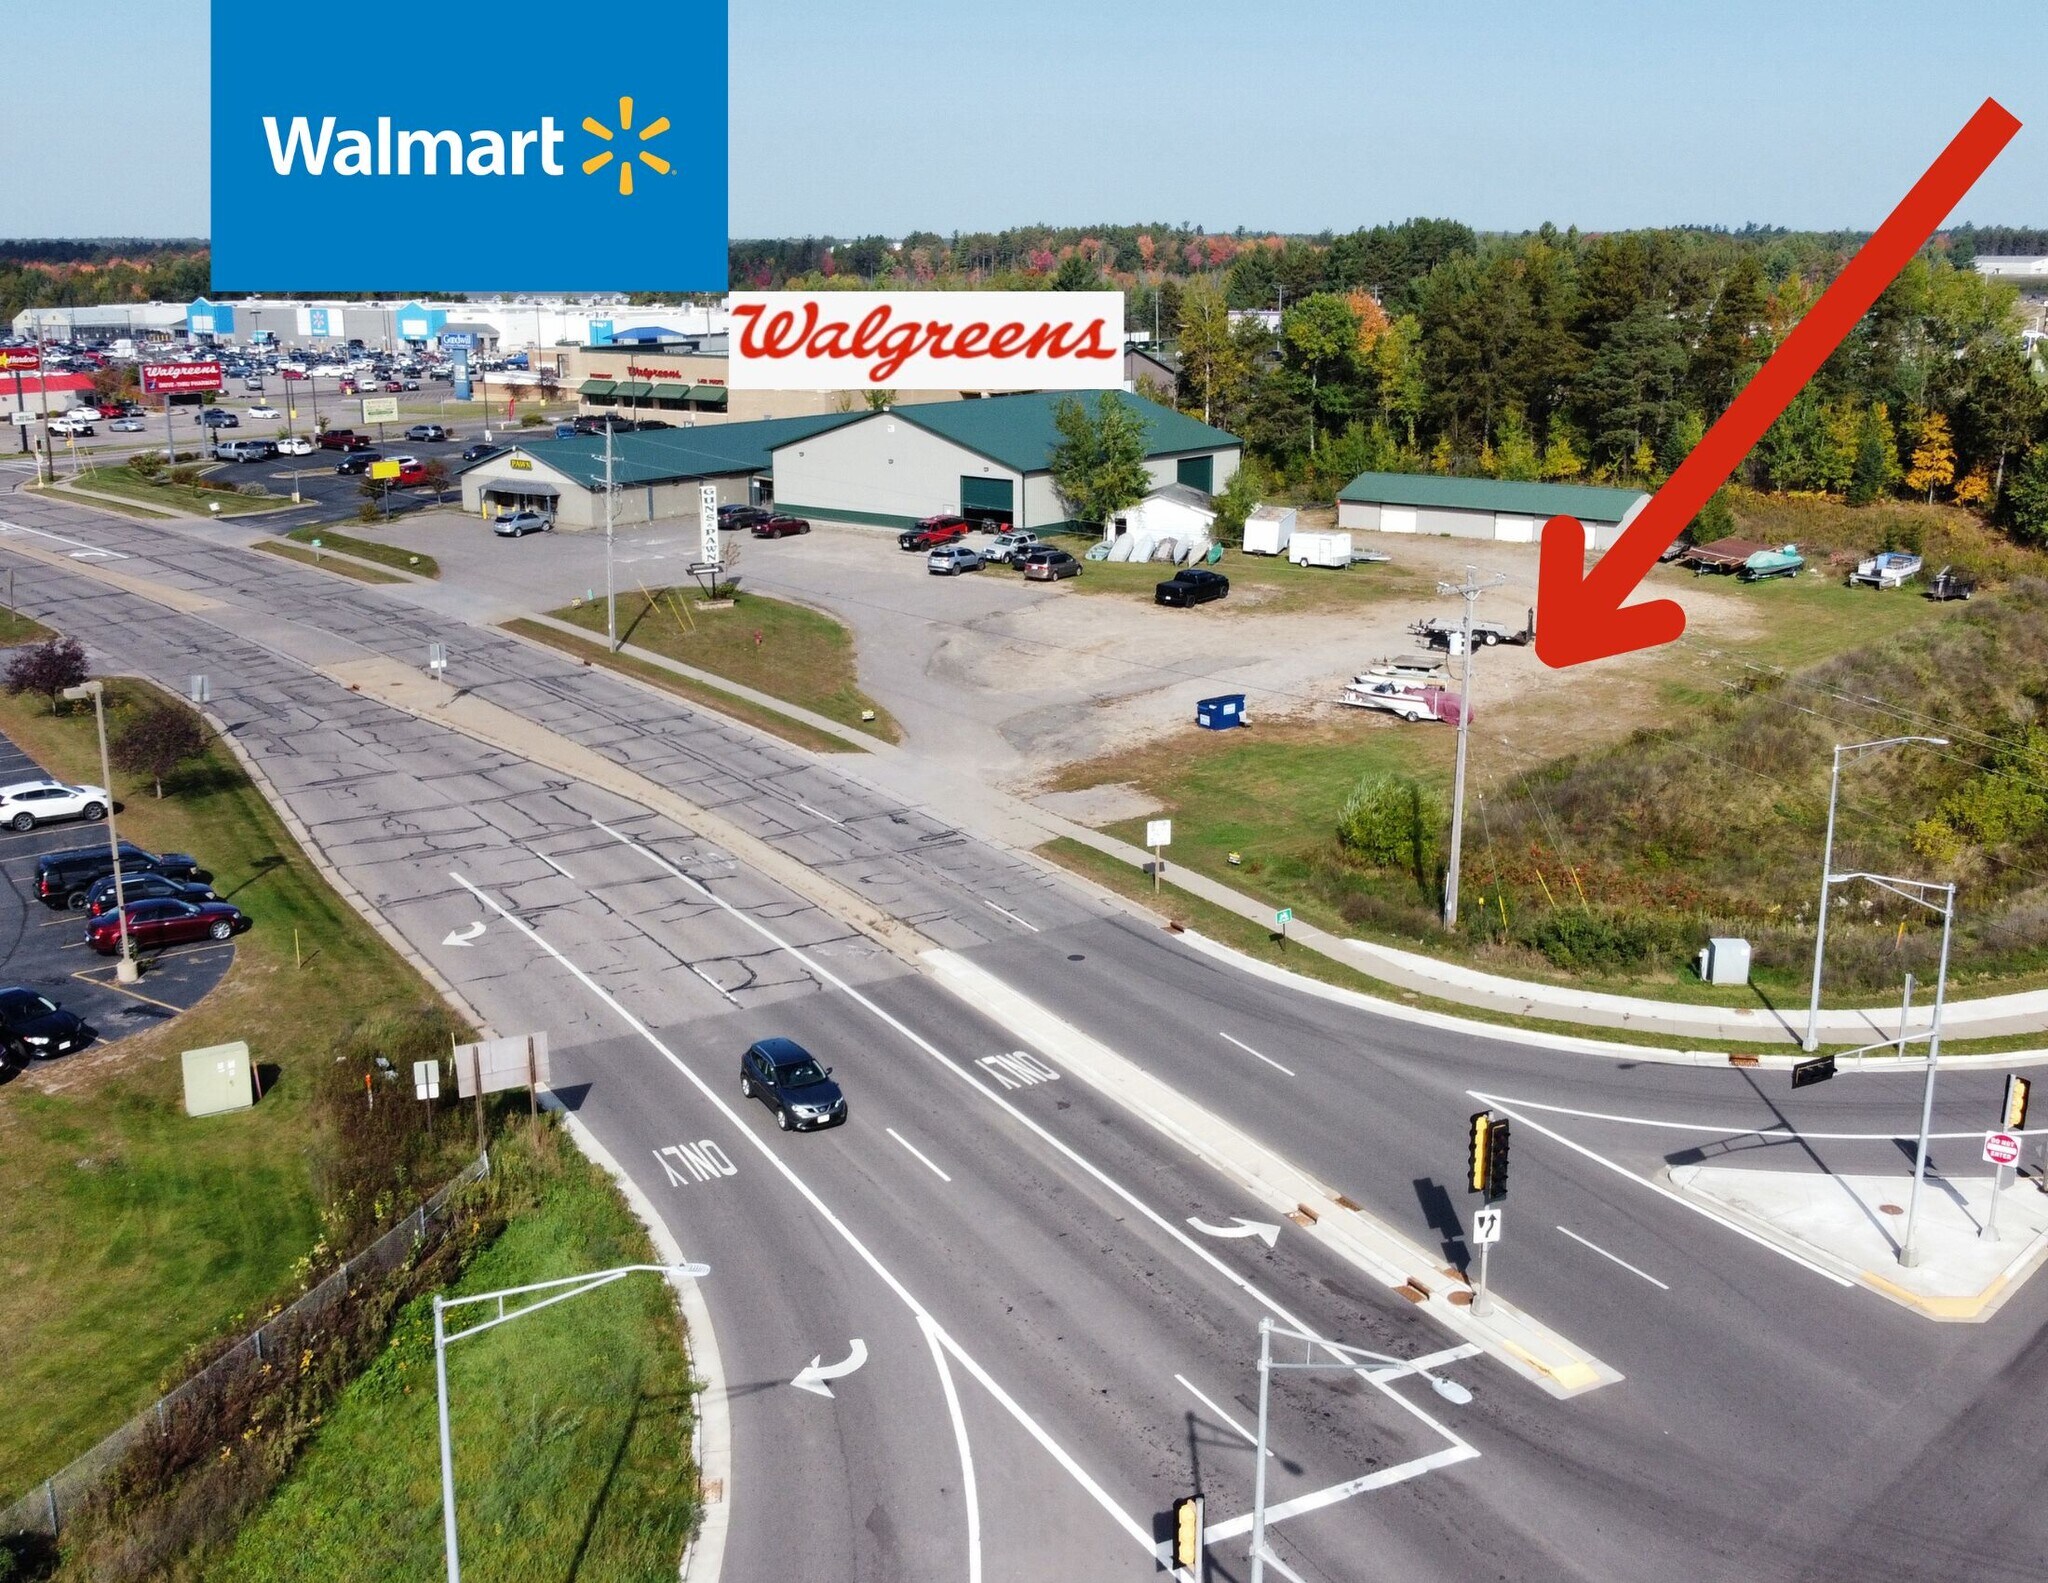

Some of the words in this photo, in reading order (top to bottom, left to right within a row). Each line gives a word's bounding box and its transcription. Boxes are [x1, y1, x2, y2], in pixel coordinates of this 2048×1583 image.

[443, 334, 471, 344] Goodwill
[145, 365, 219, 379] Walgreens
[626, 366, 682, 380] Walgreens
[511, 460, 531, 469] PAWN
[704, 488, 715, 522] GUNS
[705, 529, 717, 562] PAWN
[973, 1050, 1061, 1090] ONLY
[1990, 1137, 2000, 1145] DO
[2001, 1139, 2015, 1147] NOT
[1990, 1151, 2012, 1160] ENTER
[652, 1139, 738, 1187] ONLY
